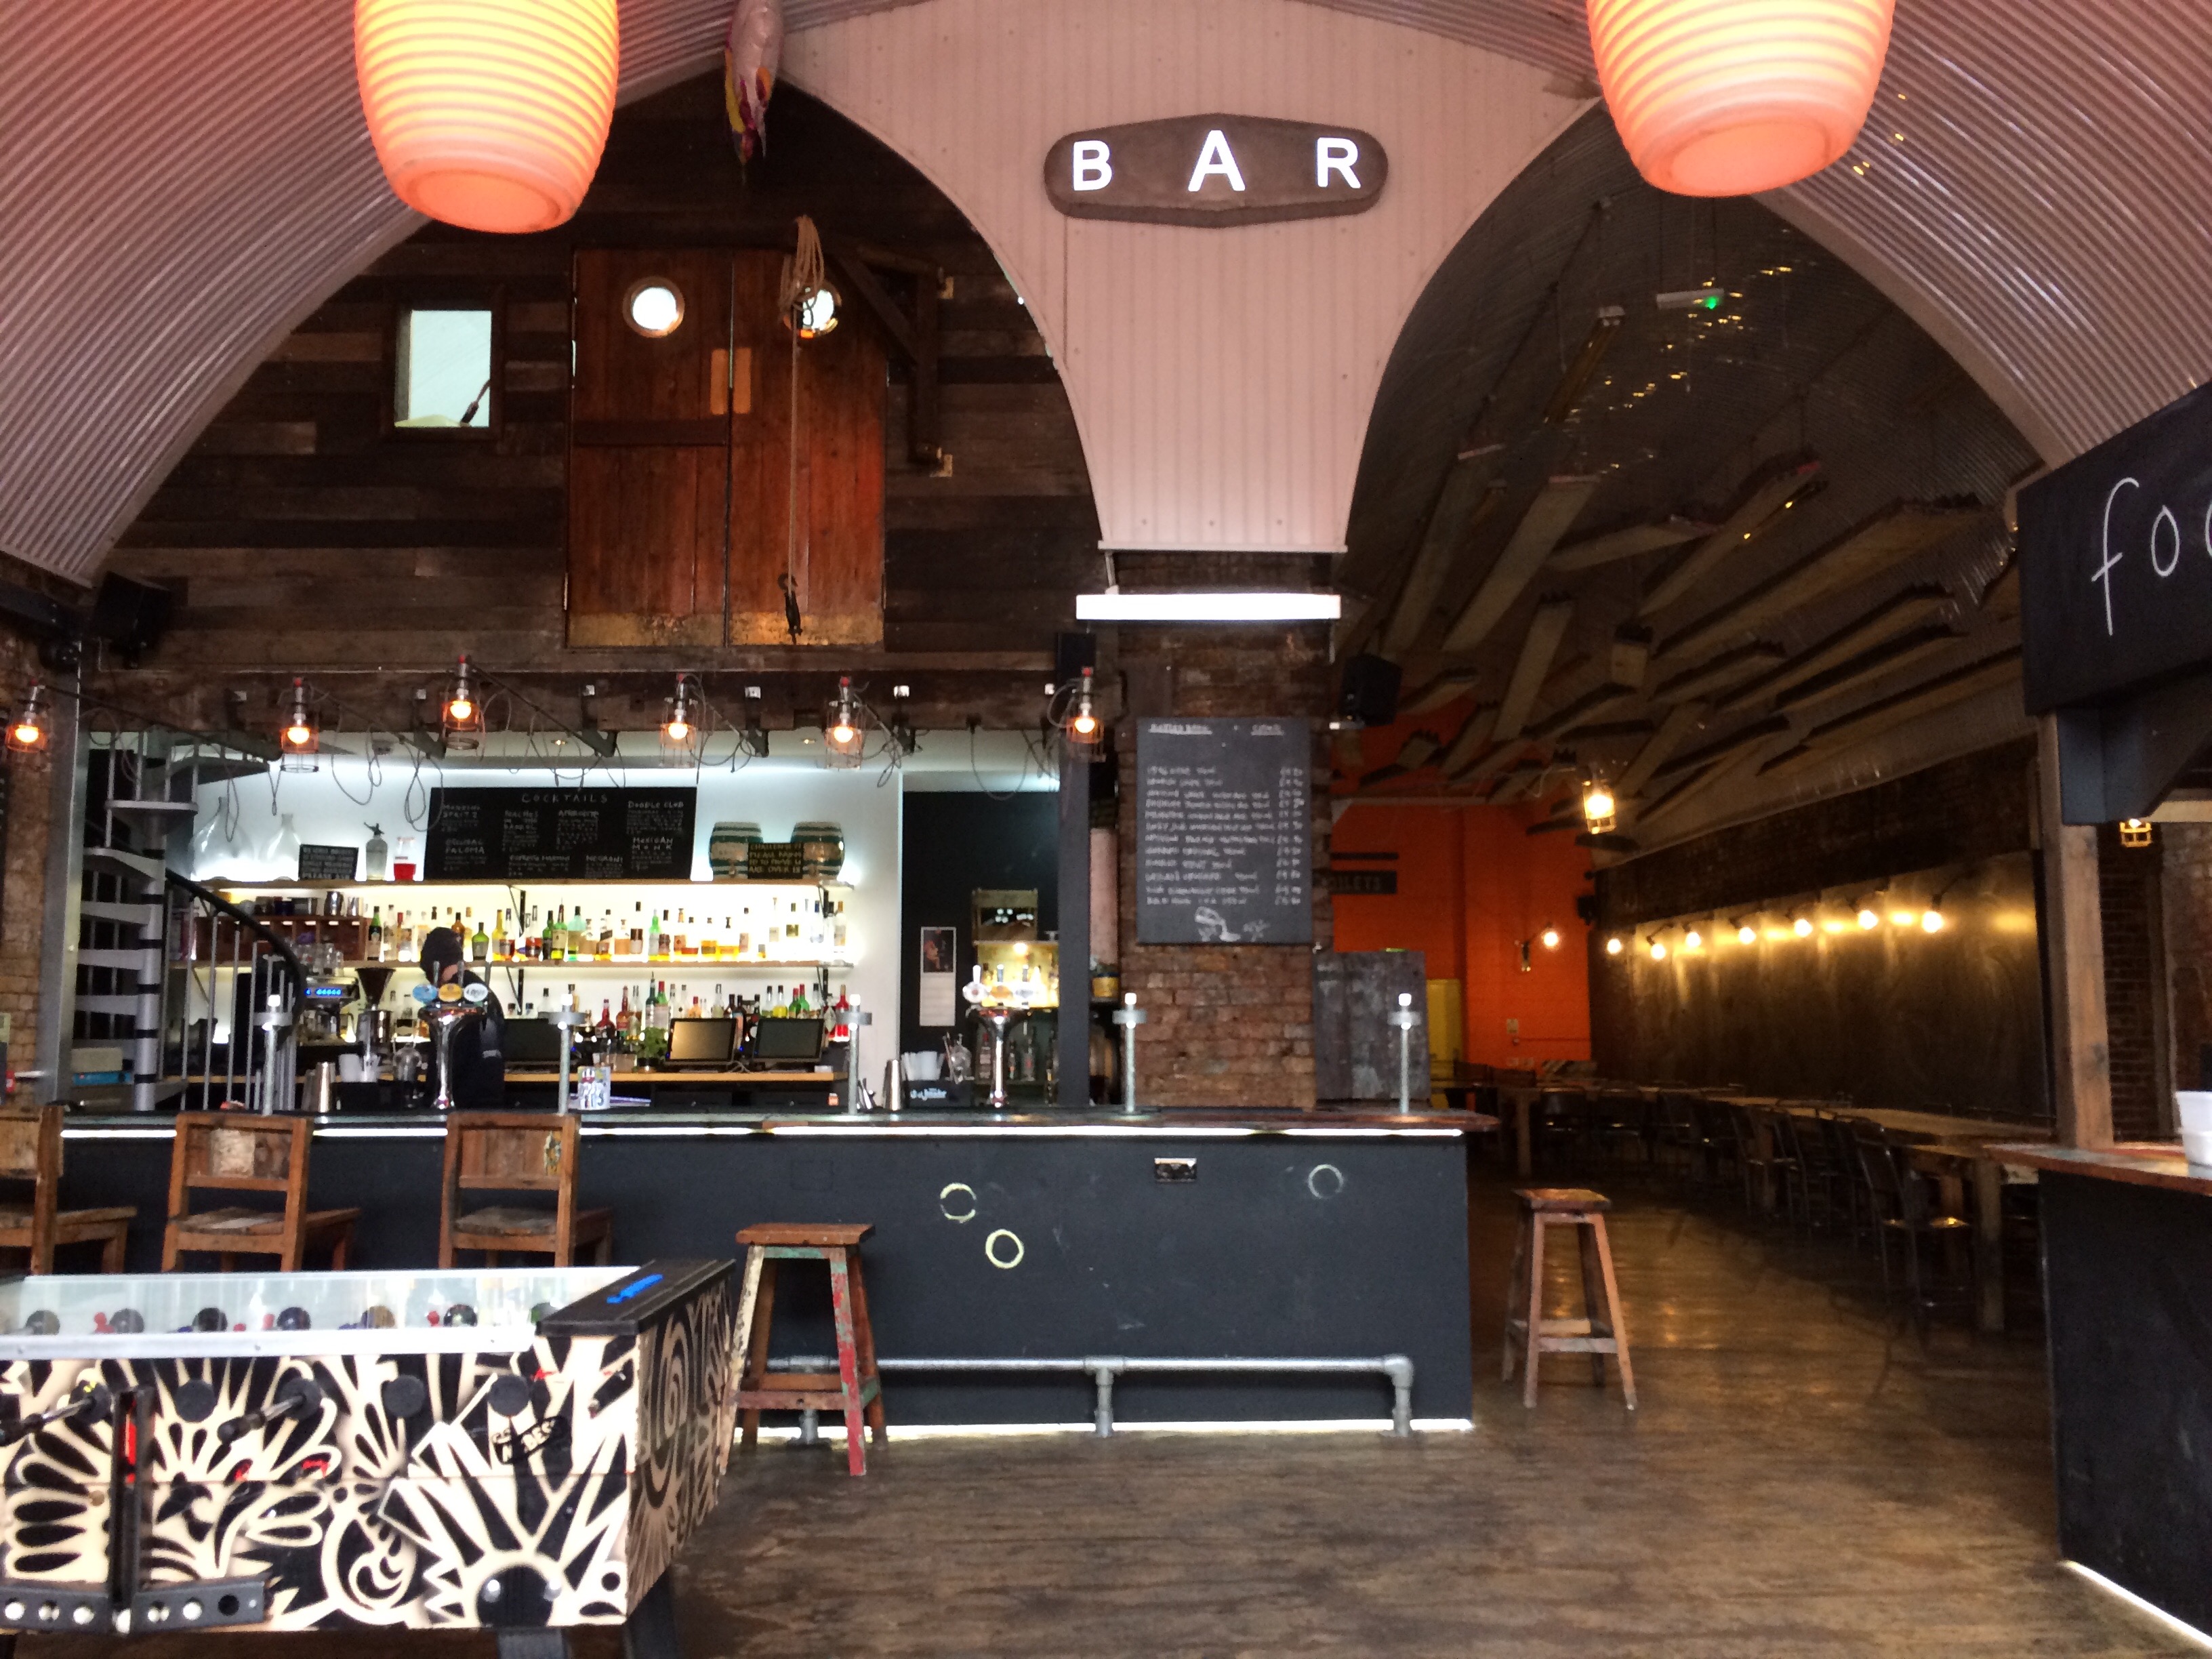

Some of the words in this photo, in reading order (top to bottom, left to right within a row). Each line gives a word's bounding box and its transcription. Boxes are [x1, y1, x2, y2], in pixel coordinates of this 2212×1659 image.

[1072, 129, 1361, 192] BAR
[2091, 476, 2212, 636] fo
[521, 793, 608, 804] COCKTAILS
